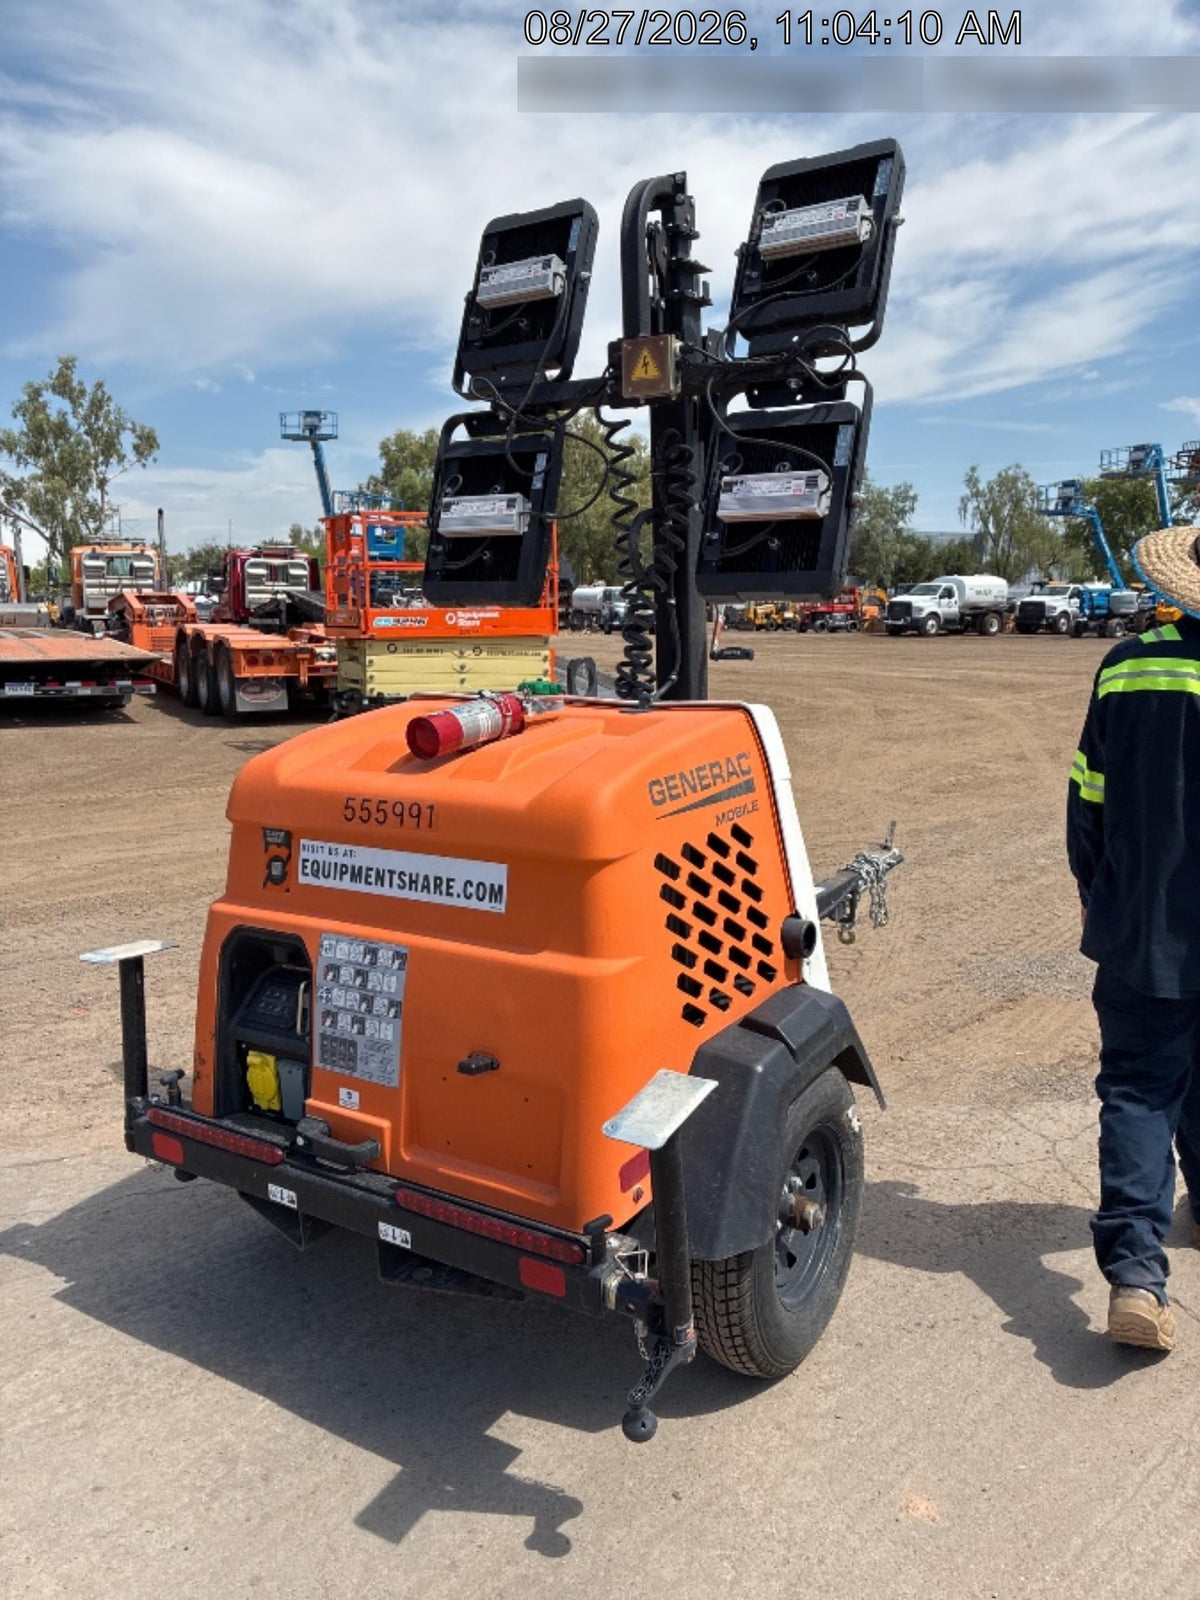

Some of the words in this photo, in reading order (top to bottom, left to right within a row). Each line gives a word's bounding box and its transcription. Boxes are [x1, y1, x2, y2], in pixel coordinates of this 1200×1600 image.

[648, 752, 752, 807] GENERAC
[343, 797, 435, 829] 555991
[715, 799, 759, 827] MOBILE
[302, 843, 325, 855] VISIT
[328, 846, 340, 857] US
[301, 857, 504, 905] EQUIPMENTSHARE.COM
